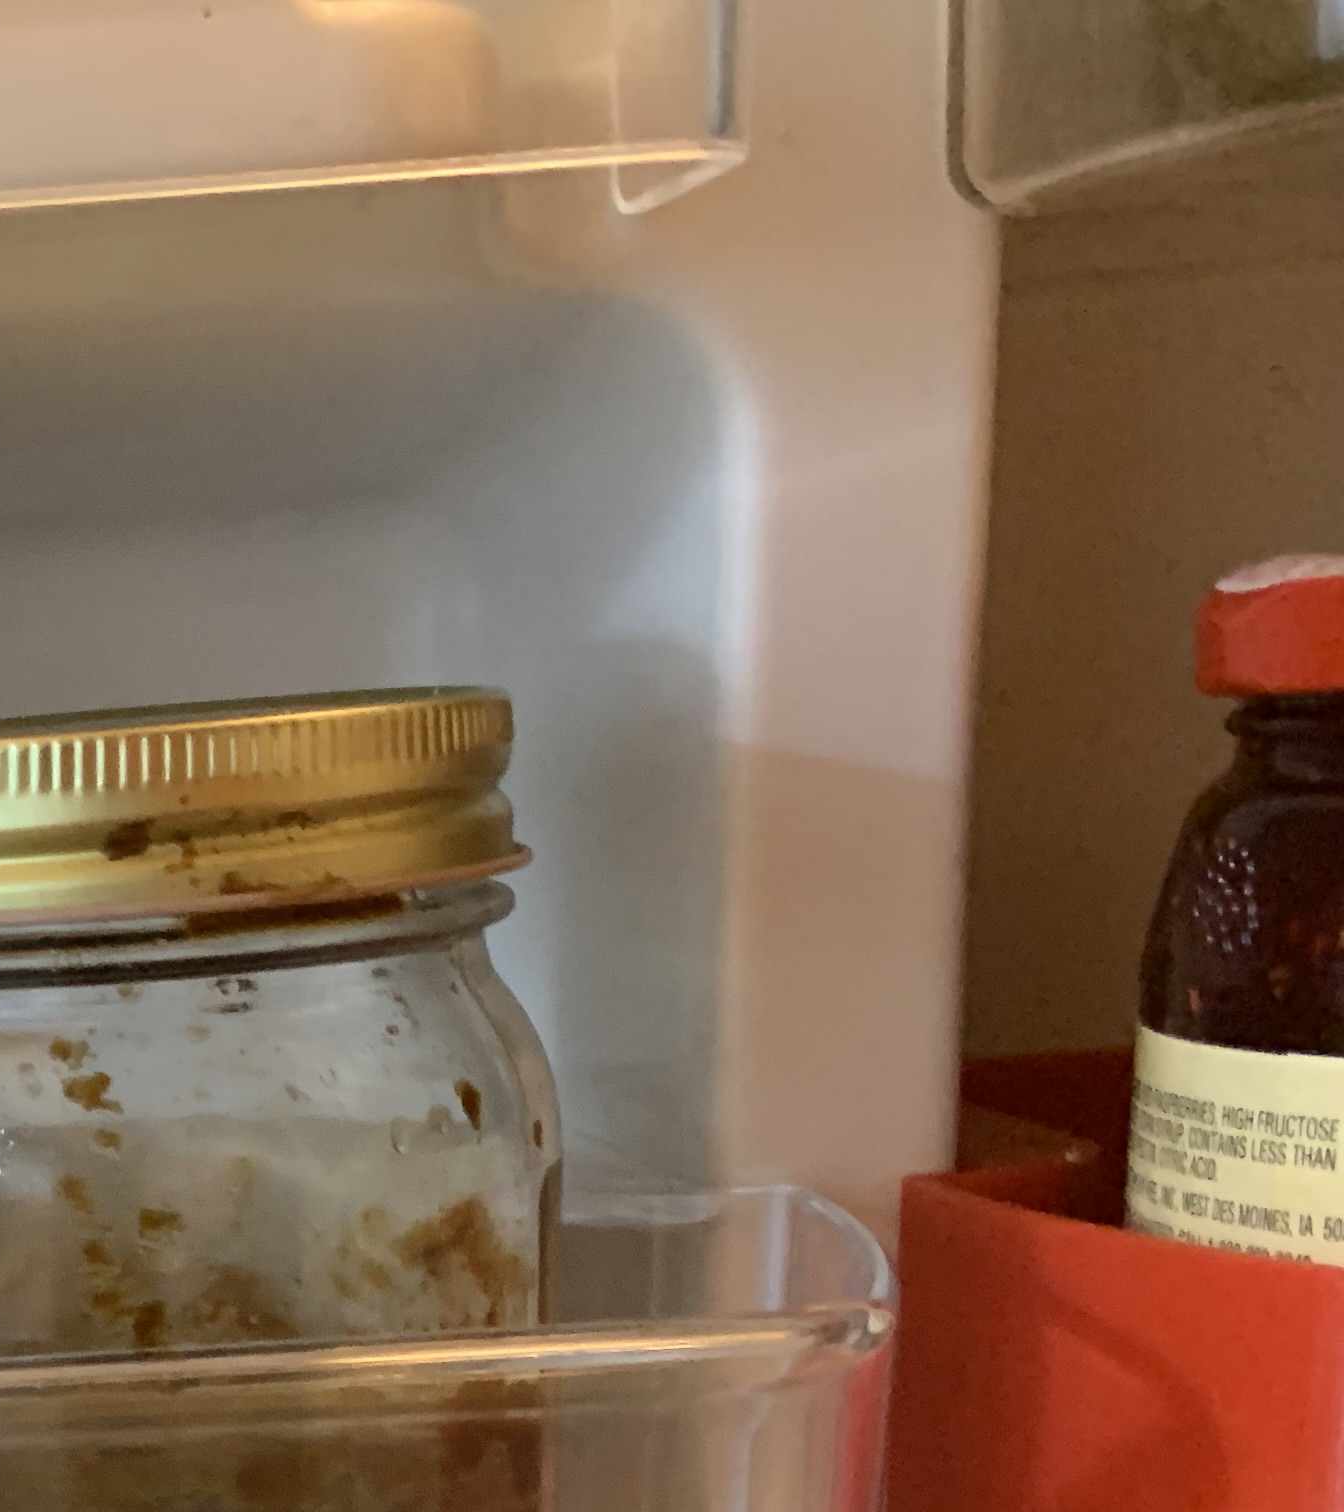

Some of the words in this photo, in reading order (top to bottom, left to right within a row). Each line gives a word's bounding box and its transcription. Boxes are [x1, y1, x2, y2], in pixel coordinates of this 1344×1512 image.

[1222, 1104, 1254, 1131] HIGH
[1257, 1110, 1340, 1143] FRUCTOSE
[1188, 1126, 1248, 1160] CONTAINS
[1251, 1138, 1287, 1166] LESS
[1293, 1144, 1337, 1172] THAN
[1182, 1191, 1211, 1218] WEST
[1212, 1198, 1235, 1222] DES
[1238, 1203, 1293, 1237] MOINES,
[1298, 1214, 1313, 1237] IA
[1323, 1216, 1344, 1243] 50
